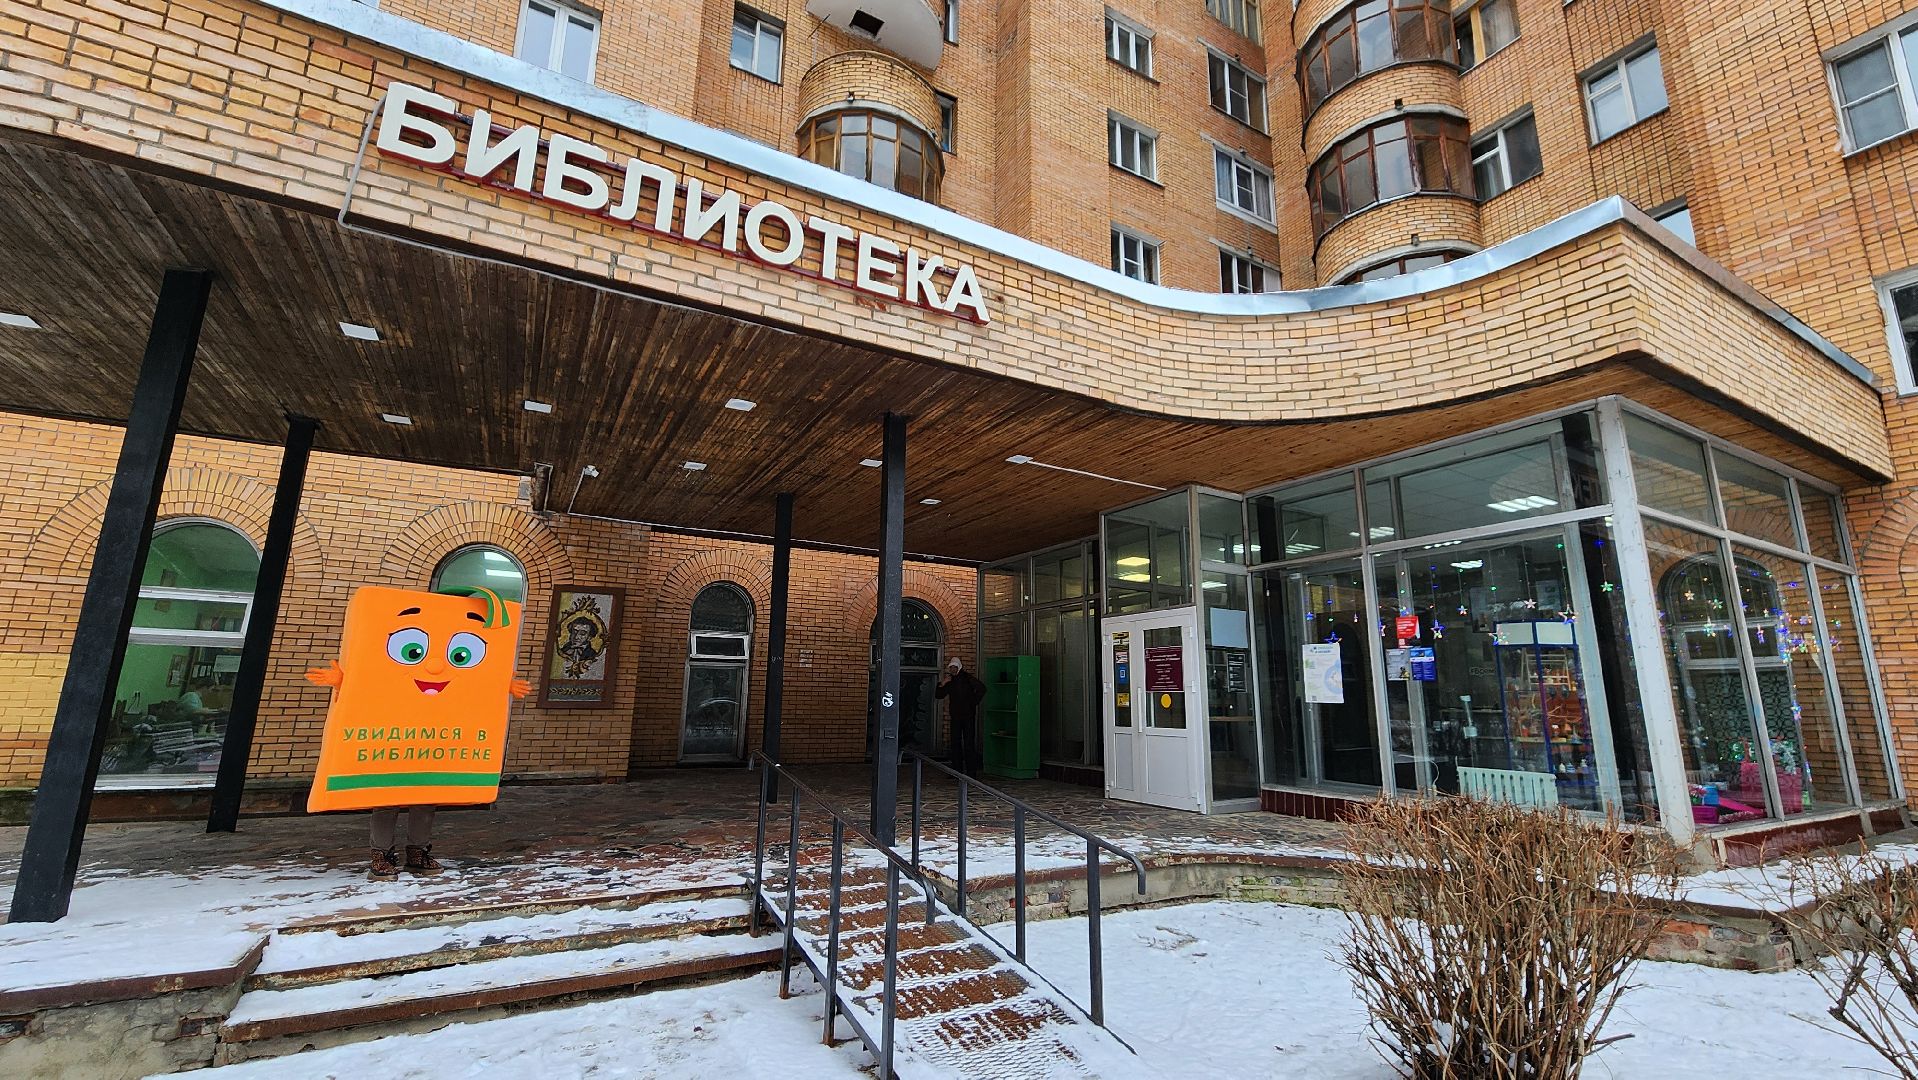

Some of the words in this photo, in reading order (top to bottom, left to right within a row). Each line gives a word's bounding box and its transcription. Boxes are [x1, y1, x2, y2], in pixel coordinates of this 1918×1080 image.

[376, 81, 991, 325] БИБЛИОТЕКА
[343, 727, 461, 742] УВИДИМСЯ
[477, 729, 487, 742] В
[357, 747, 491, 762] БИБЛИОТЕКЕ
